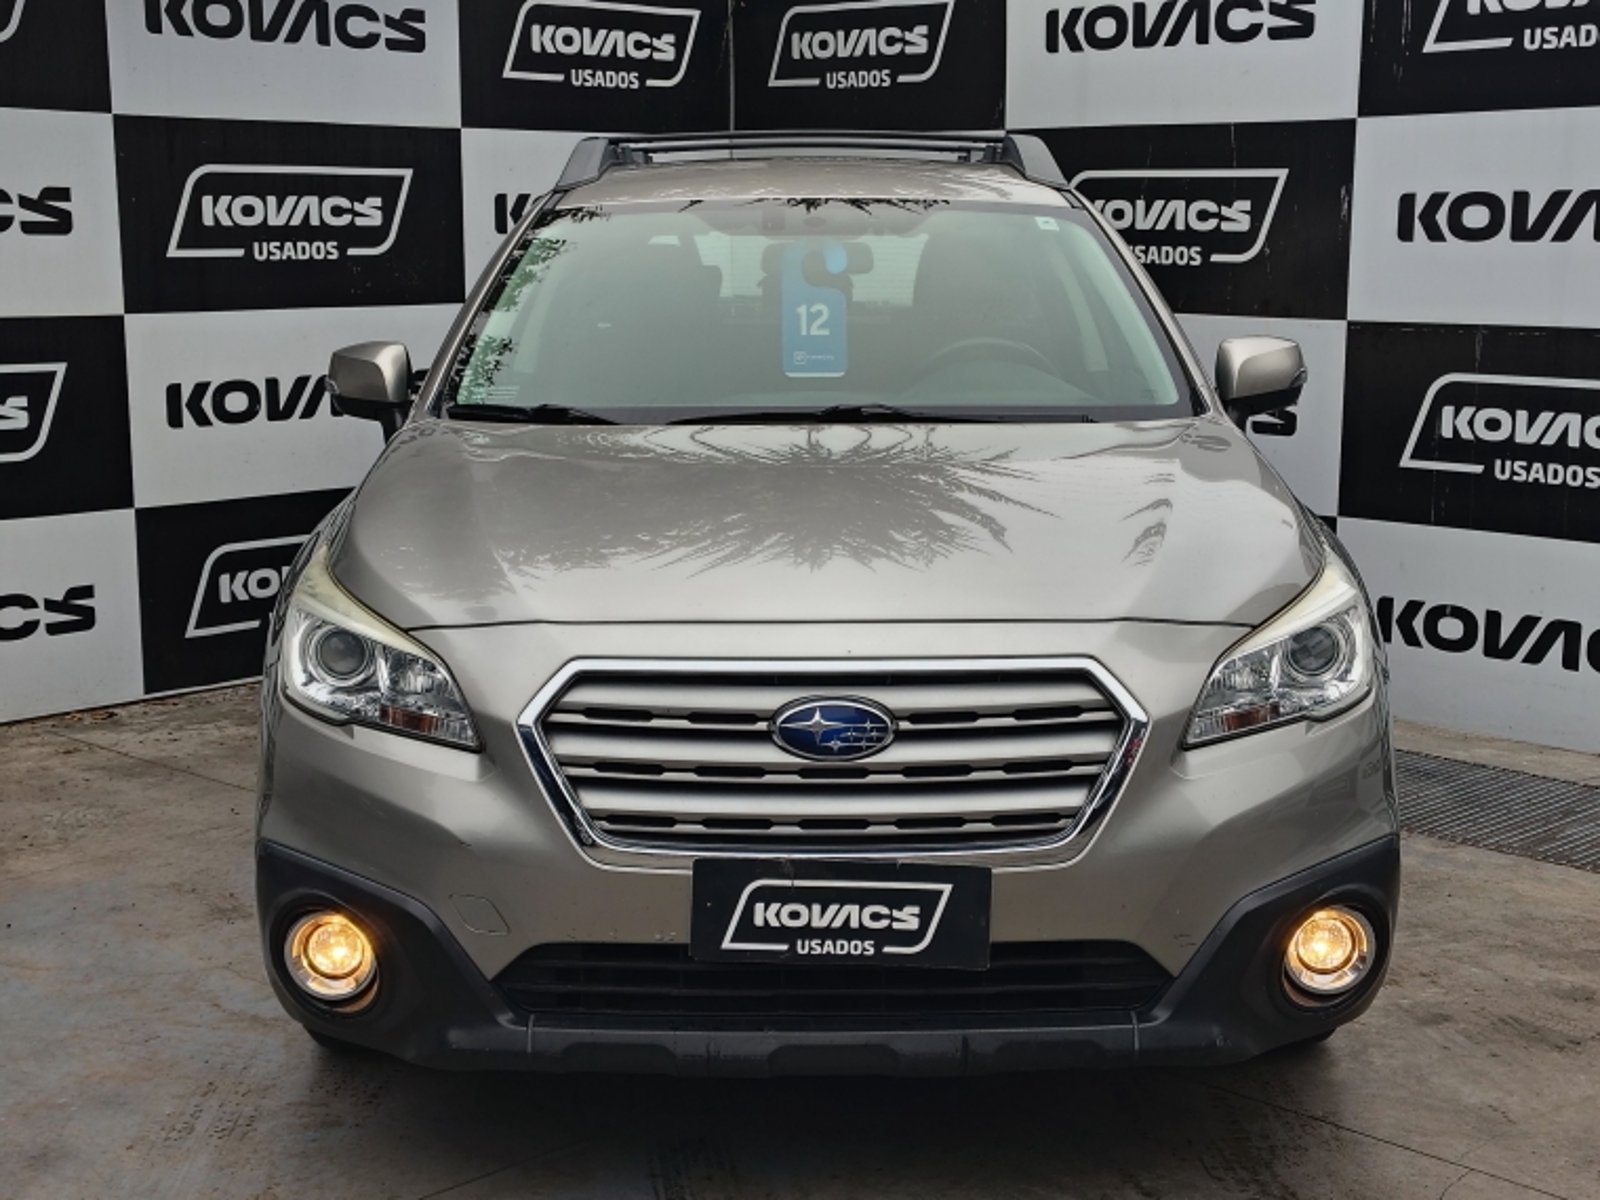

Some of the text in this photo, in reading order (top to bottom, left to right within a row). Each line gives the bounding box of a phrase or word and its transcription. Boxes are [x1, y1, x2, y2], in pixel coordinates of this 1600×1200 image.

[144, 0, 426, 53] KOVACS
[1045, 0, 1316, 54] KOVACS
[531, 24, 676, 61] KOVACS
[791, 25, 929, 60] KOVACS
[571, 69, 640, 90] USADOS
[826, 69, 892, 90] USADOS
[201, 195, 383, 227] KOVACS
[253, 240, 339, 261] USADOS
[1130, 245, 1203, 266] SADOS
[795, 302, 831, 336] 12
[1494, 458, 1600, 489] USADOS
[1377, 595, 1600, 674] KOVA
[753, 902, 921, 932] KOVACS
[797, 938, 875, 956] USADOS
